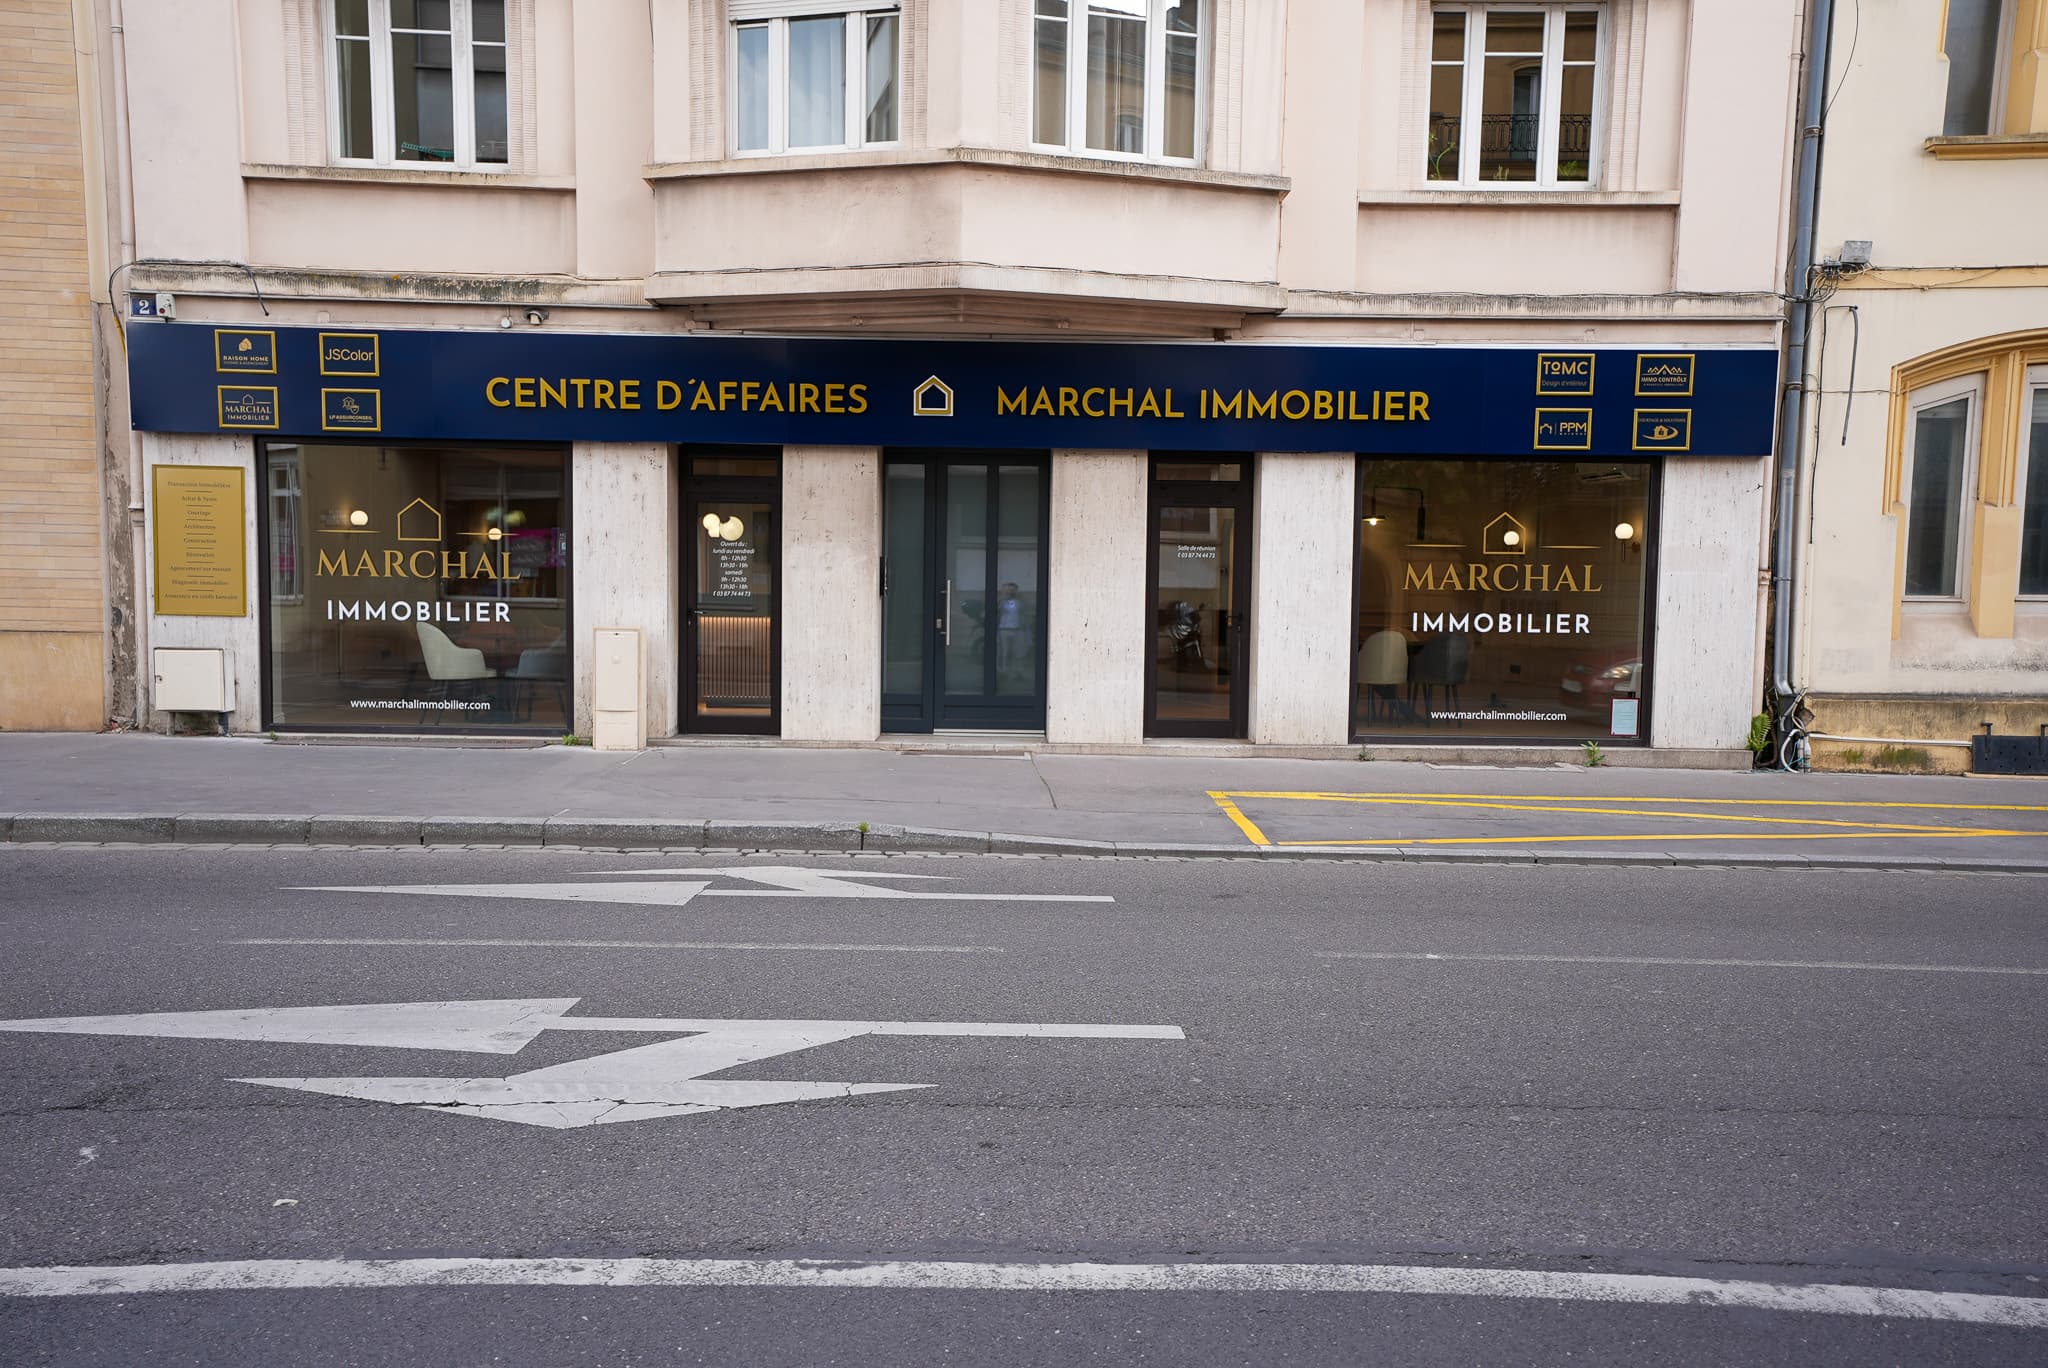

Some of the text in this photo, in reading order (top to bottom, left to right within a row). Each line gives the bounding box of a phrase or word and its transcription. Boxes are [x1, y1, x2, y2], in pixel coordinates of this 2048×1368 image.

[139, 299, 150, 314] 2
[325, 348, 374, 361] JSColor
[486, 377, 641, 410] CENTRE
[225, 405, 272, 414] MARCHAL
[997, 386, 1431, 421] MARCHAL IMMOBILIER
[1560, 422, 1587, 433] PPM
[315, 548, 521, 580] MARCHAL
[1402, 562, 1603, 592] MARCHAL
[327, 600, 511, 622] IMMOBILIER
[1412, 612, 1590, 634] IMMOBILIER
[350, 699, 491, 711] www.marchalimmobilier.com
[1430, 710, 1567, 721] www.marchalimmobilier.com
